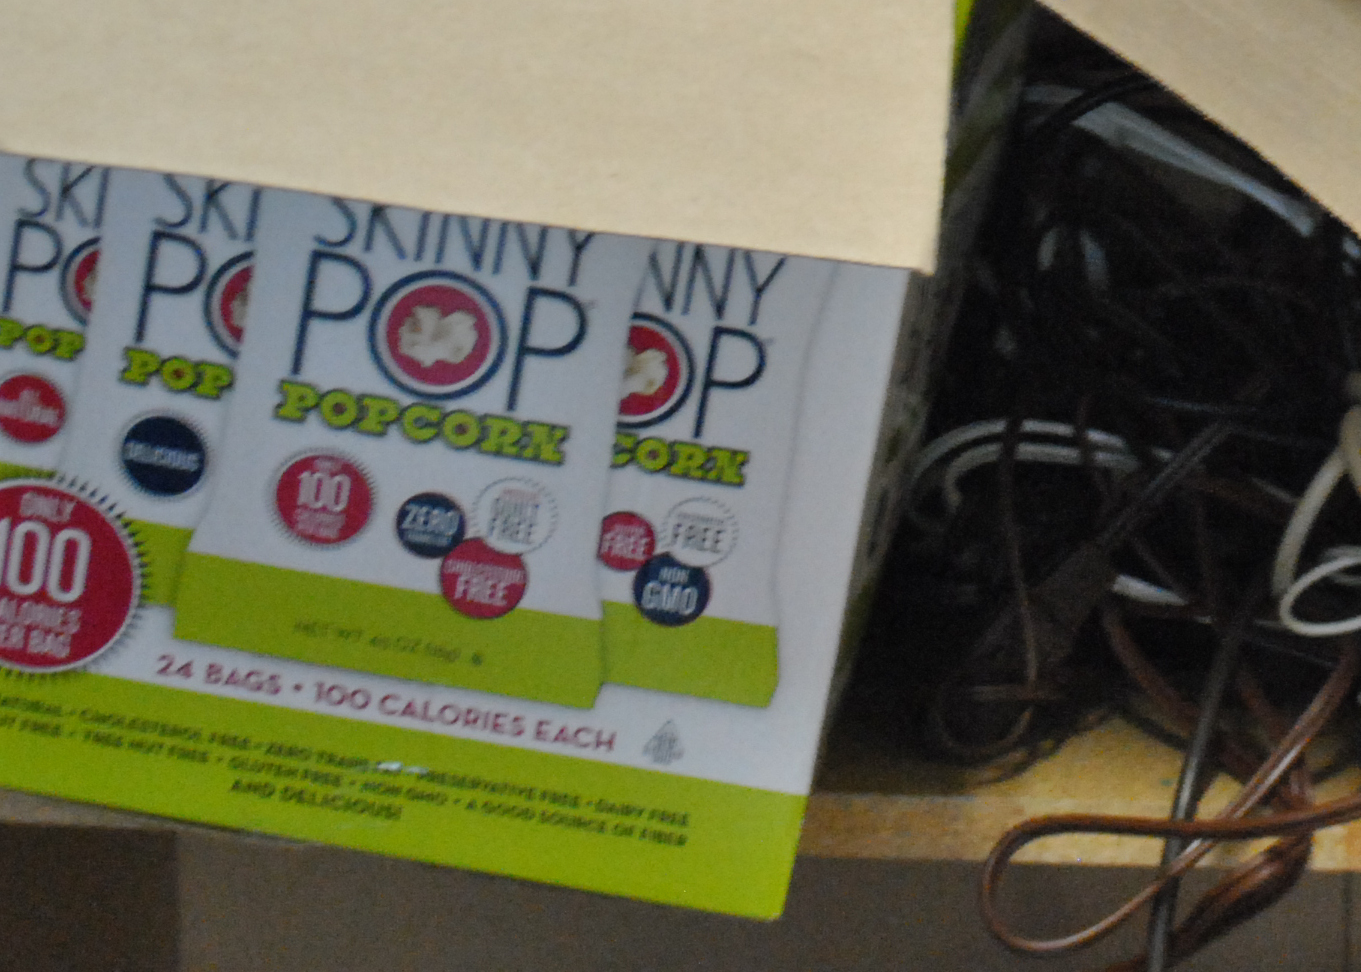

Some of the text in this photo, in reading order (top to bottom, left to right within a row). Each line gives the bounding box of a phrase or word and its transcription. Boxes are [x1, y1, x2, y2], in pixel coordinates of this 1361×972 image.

[313, 196, 596, 287] SKINNY
[290, 249, 589, 412] POP
[272, 378, 572, 468] POPCORN
[296, 470, 352, 513] 100
[401, 503, 461, 537] ZERO
[672, 521, 724, 555] FREE
[600, 529, 651, 561] FREE
[454, 573, 510, 607] FREE
[641, 580, 700, 616] GMO
[156, 653, 618, 753] 24 BAGS 100 CALORIES EACH
